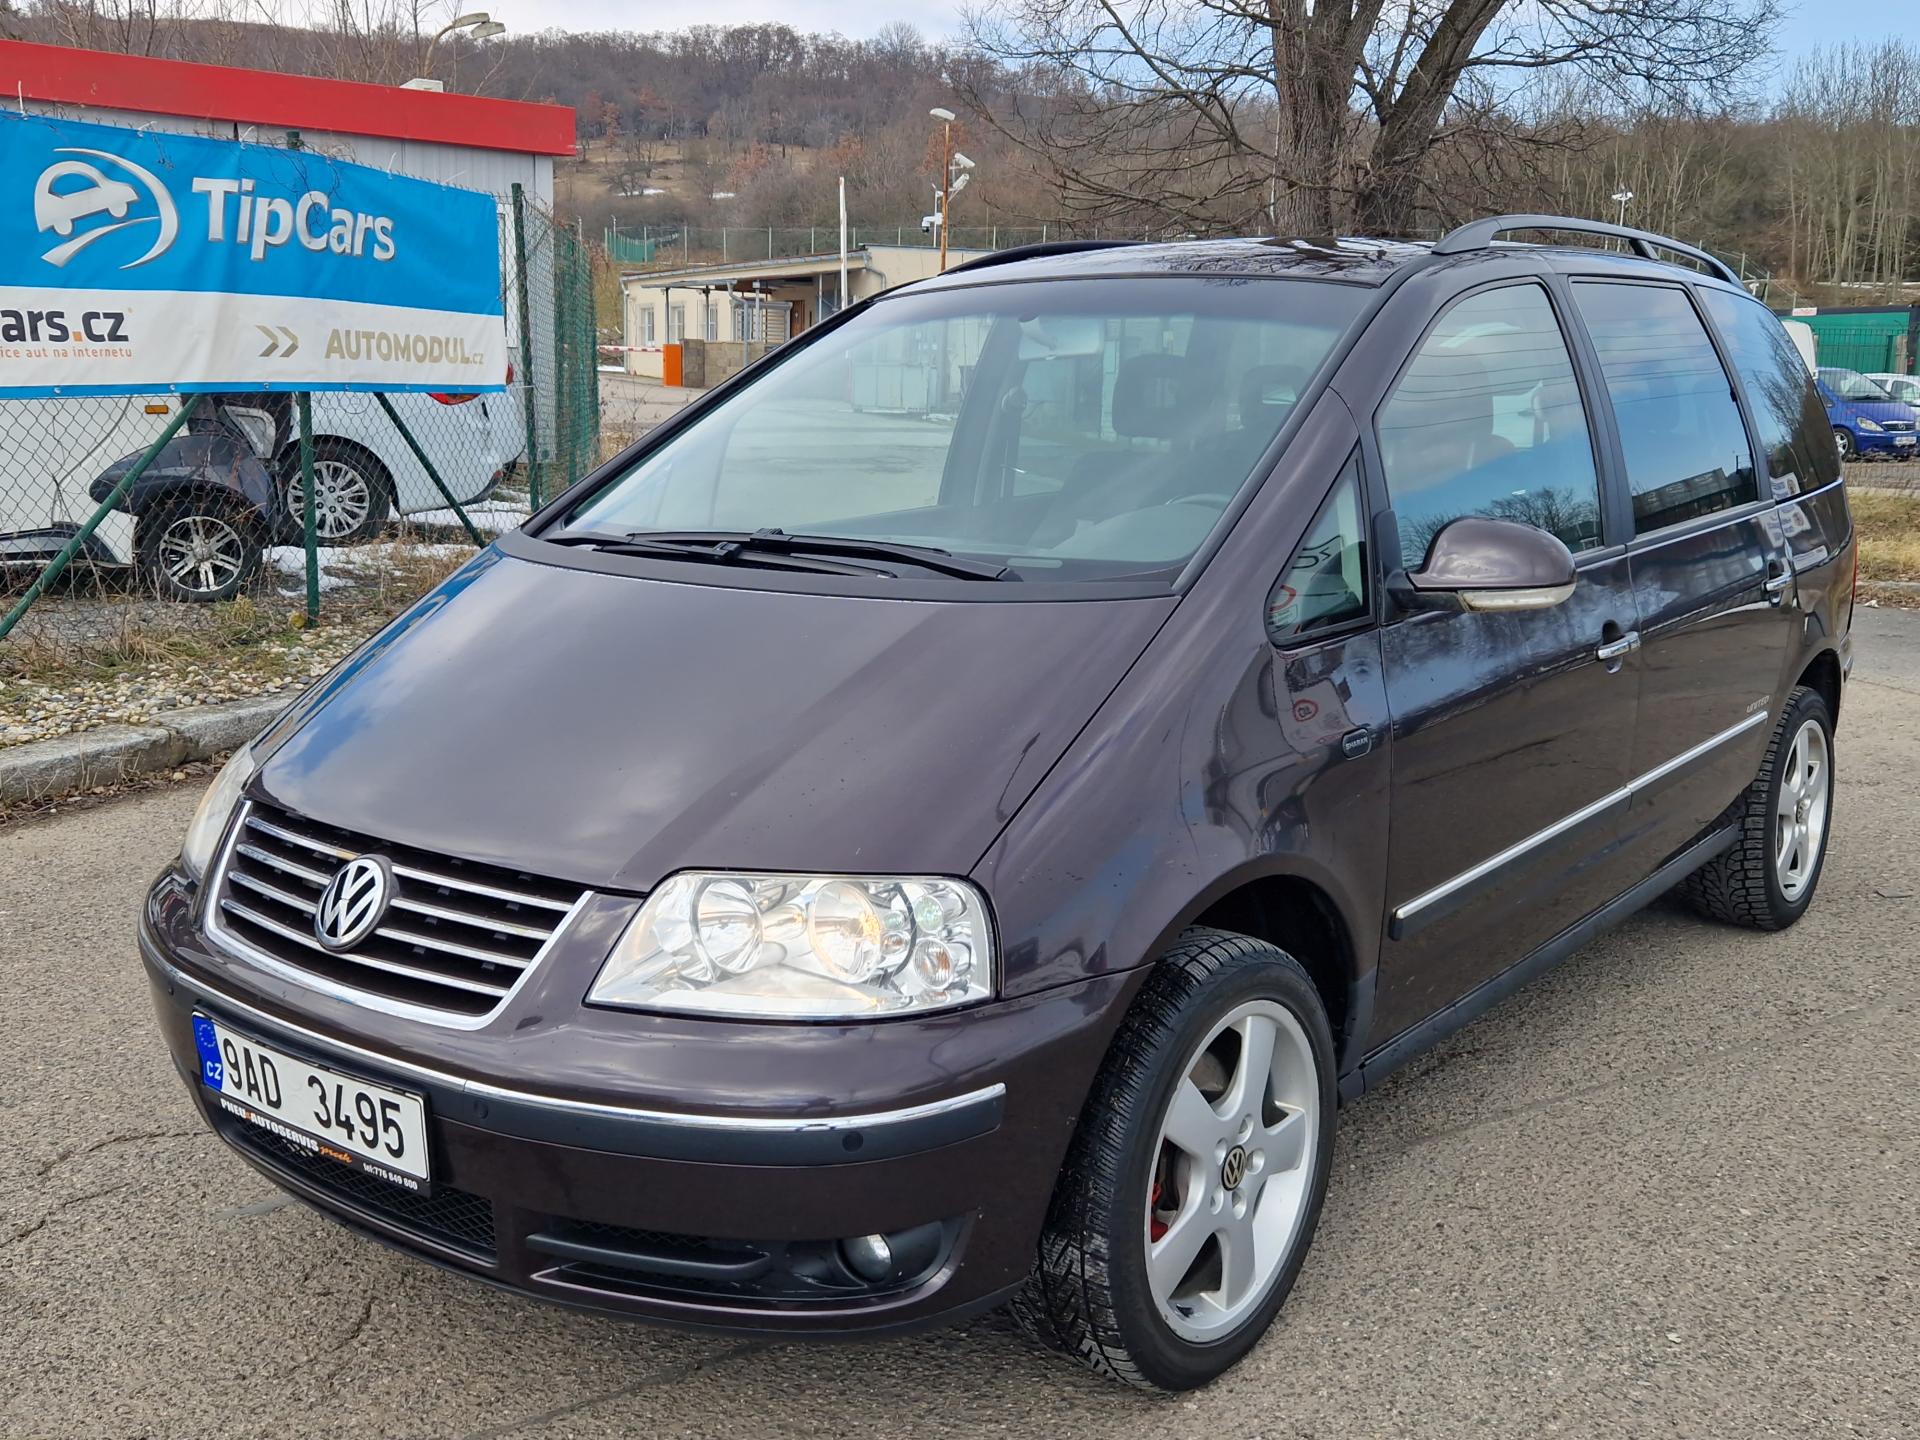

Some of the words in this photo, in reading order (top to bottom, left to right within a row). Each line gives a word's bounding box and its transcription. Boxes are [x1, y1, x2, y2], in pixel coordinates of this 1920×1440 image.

[192, 177, 396, 262] TipCars
[26, 348, 48, 358] aut
[53, 348, 68, 358] na
[72, 346, 133, 358] internetu
[324, 328, 485, 365] AUTOMODUL.cz
[206, 1061, 222, 1081] CZ
[223, 1038, 282, 1110] 9AD
[307, 1075, 405, 1159] 3495
